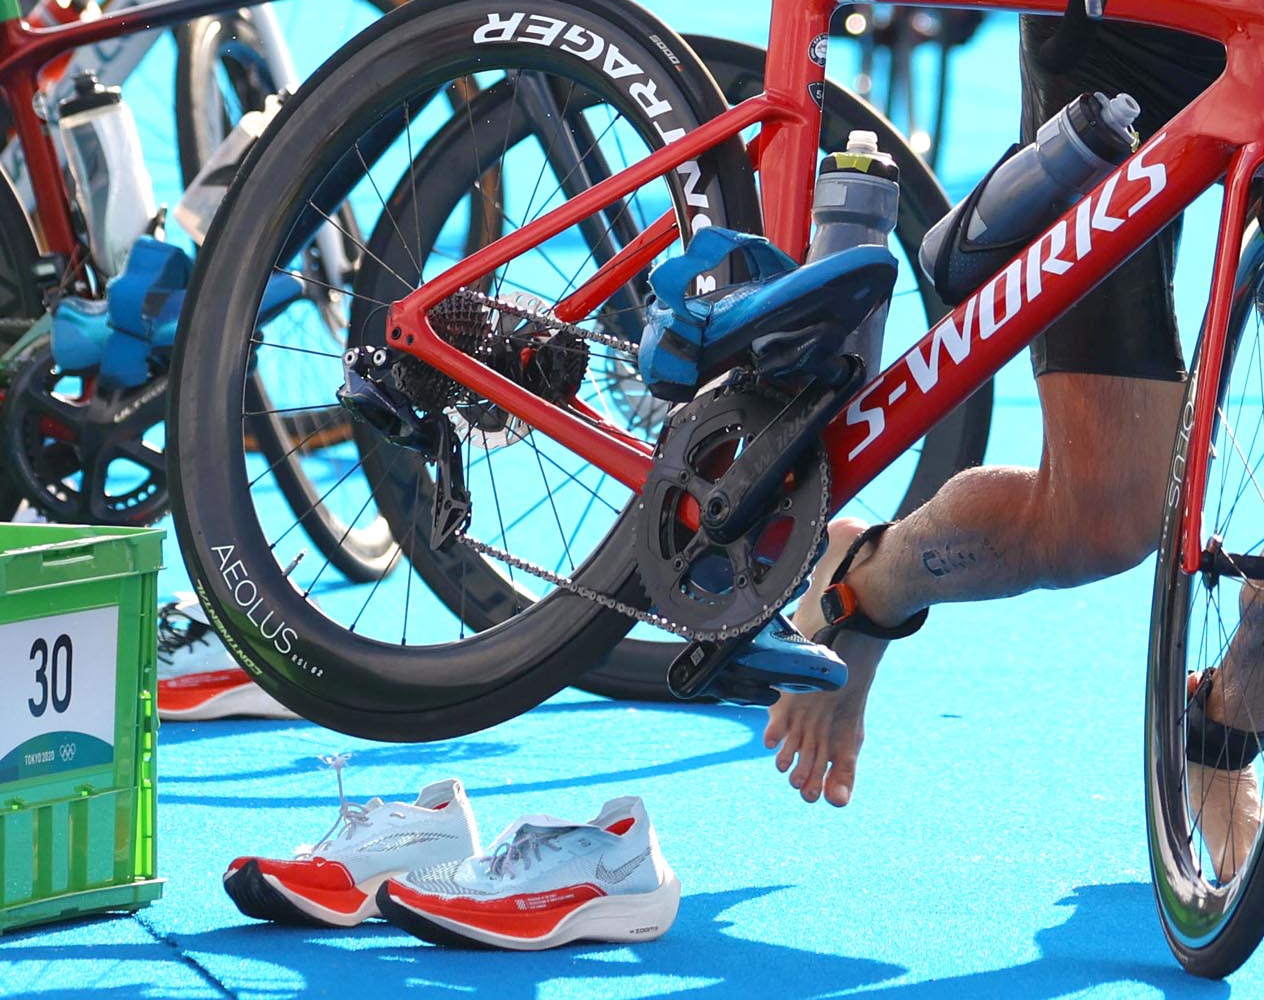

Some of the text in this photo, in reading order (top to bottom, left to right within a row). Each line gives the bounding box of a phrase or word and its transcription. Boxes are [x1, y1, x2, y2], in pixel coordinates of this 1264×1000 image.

[846, 132, 1168, 462] S-WORKS
[197, 578, 264, 676] CONTINENTAL
[211, 545, 299, 654] AEOLUS
[28, 634, 73, 718] 30
[24, 750, 55, 766] TOKYO 2020
